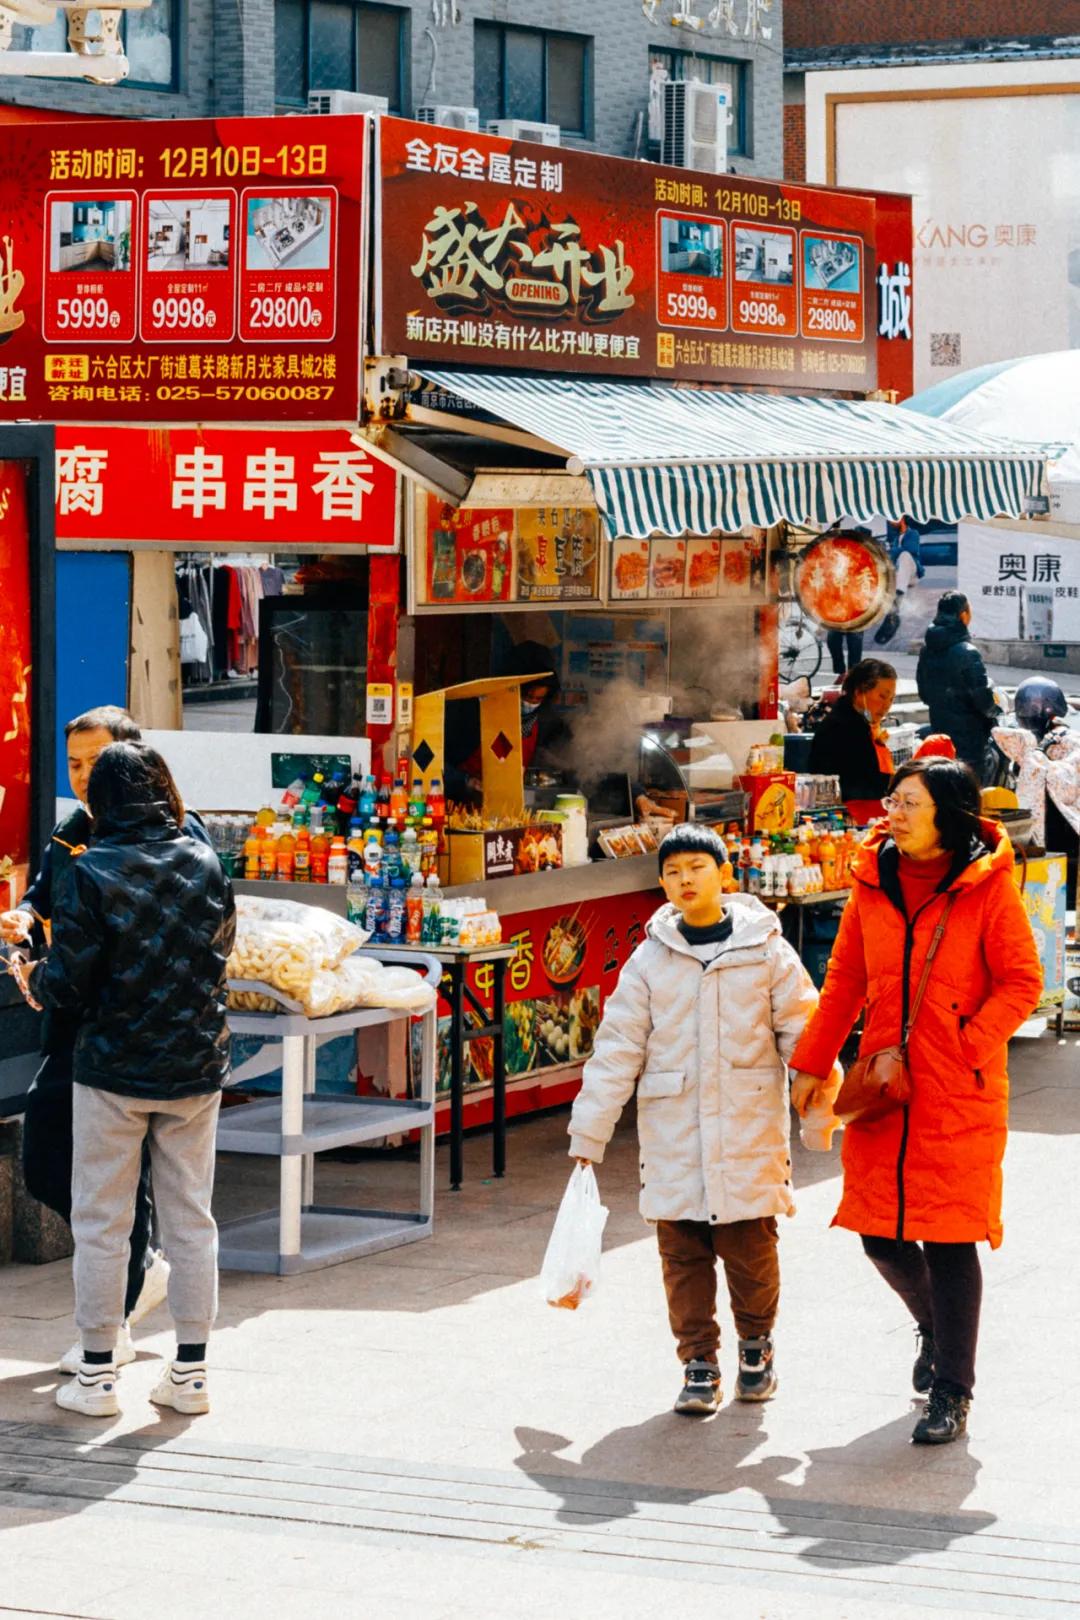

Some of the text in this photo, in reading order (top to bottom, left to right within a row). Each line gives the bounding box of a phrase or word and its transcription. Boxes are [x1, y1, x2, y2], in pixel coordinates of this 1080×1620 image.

[405, 138, 563, 193] 全友全屋定制
[411, 201, 635, 311] 盛大开业
[995, 224, 1037, 247] 奥康
[511, 282, 561, 301] OPENING
[876, 261, 912, 340] 城
[406, 315, 641, 360] 新店开业没有什么比开业更便宜
[0, 366, 27, 401] 宜
[55, 445, 375, 522] 腐 串串香
[998, 553, 1061, 583] 奥康
